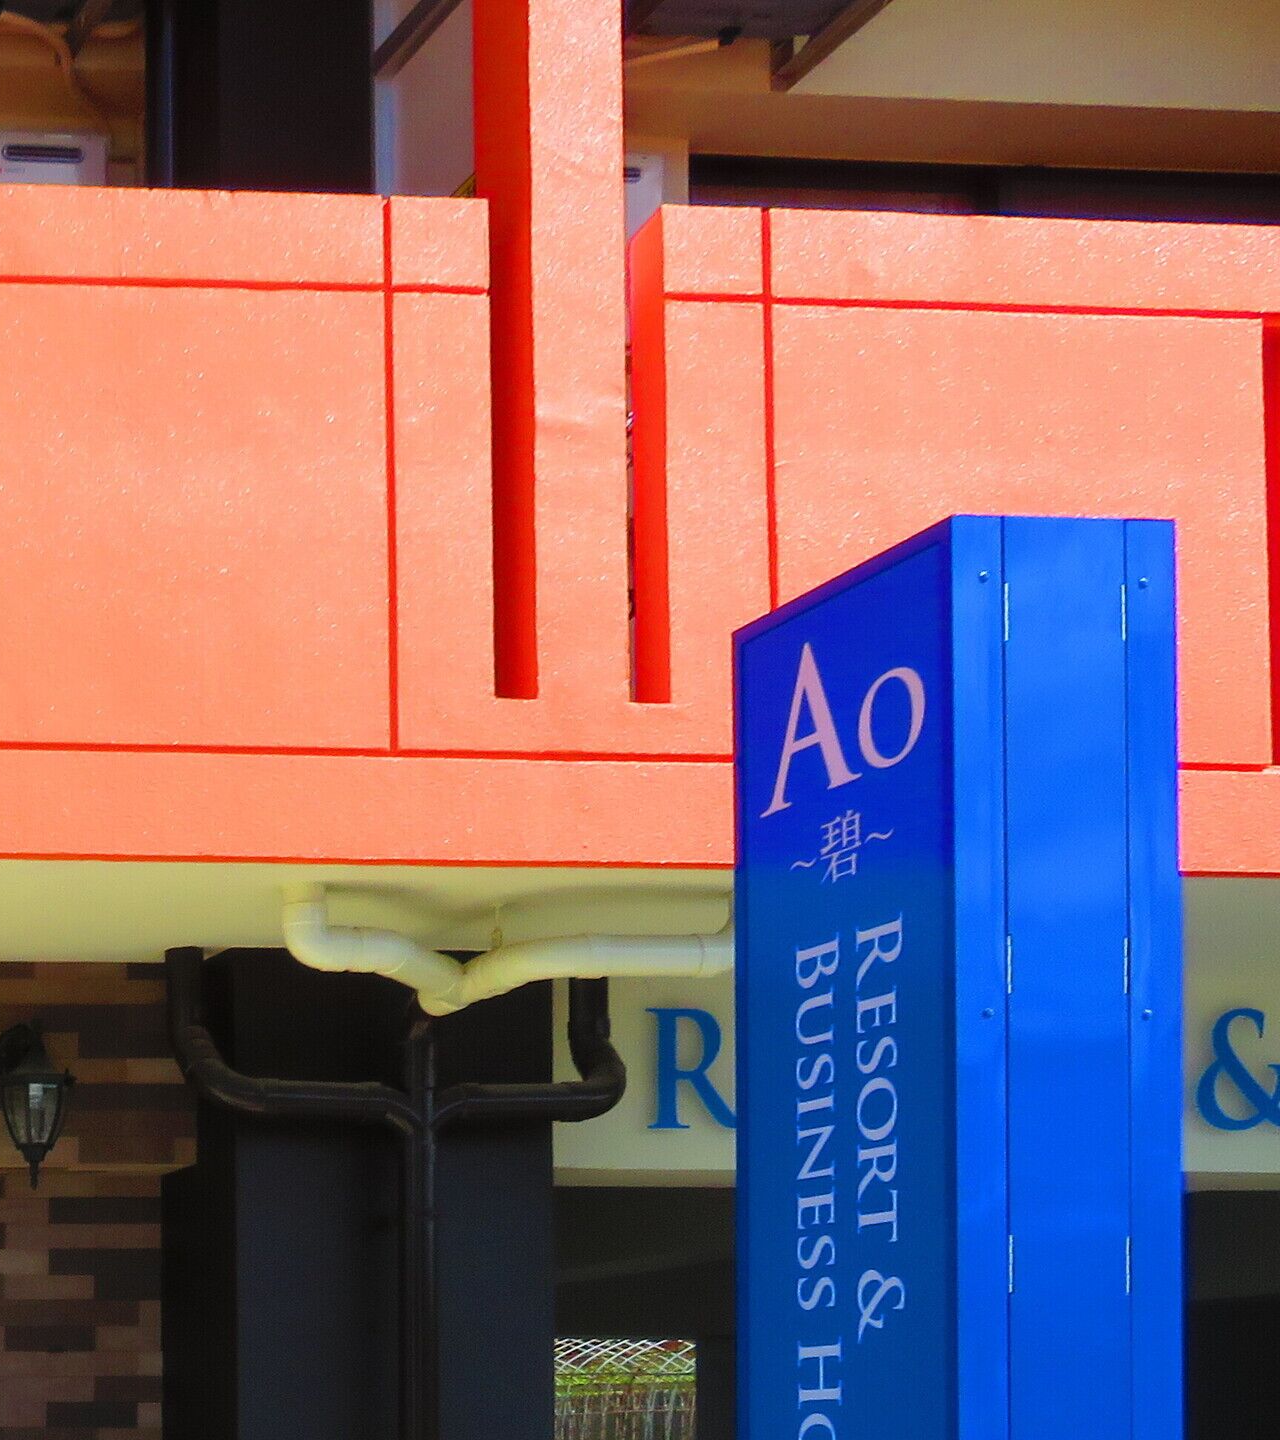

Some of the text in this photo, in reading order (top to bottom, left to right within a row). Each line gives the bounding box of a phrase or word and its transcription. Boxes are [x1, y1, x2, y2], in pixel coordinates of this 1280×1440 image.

[759, 641, 926, 818] Ao
[795, 931, 840, 1311] BUSINESS
[856, 912, 906, 1344] RESORT &
